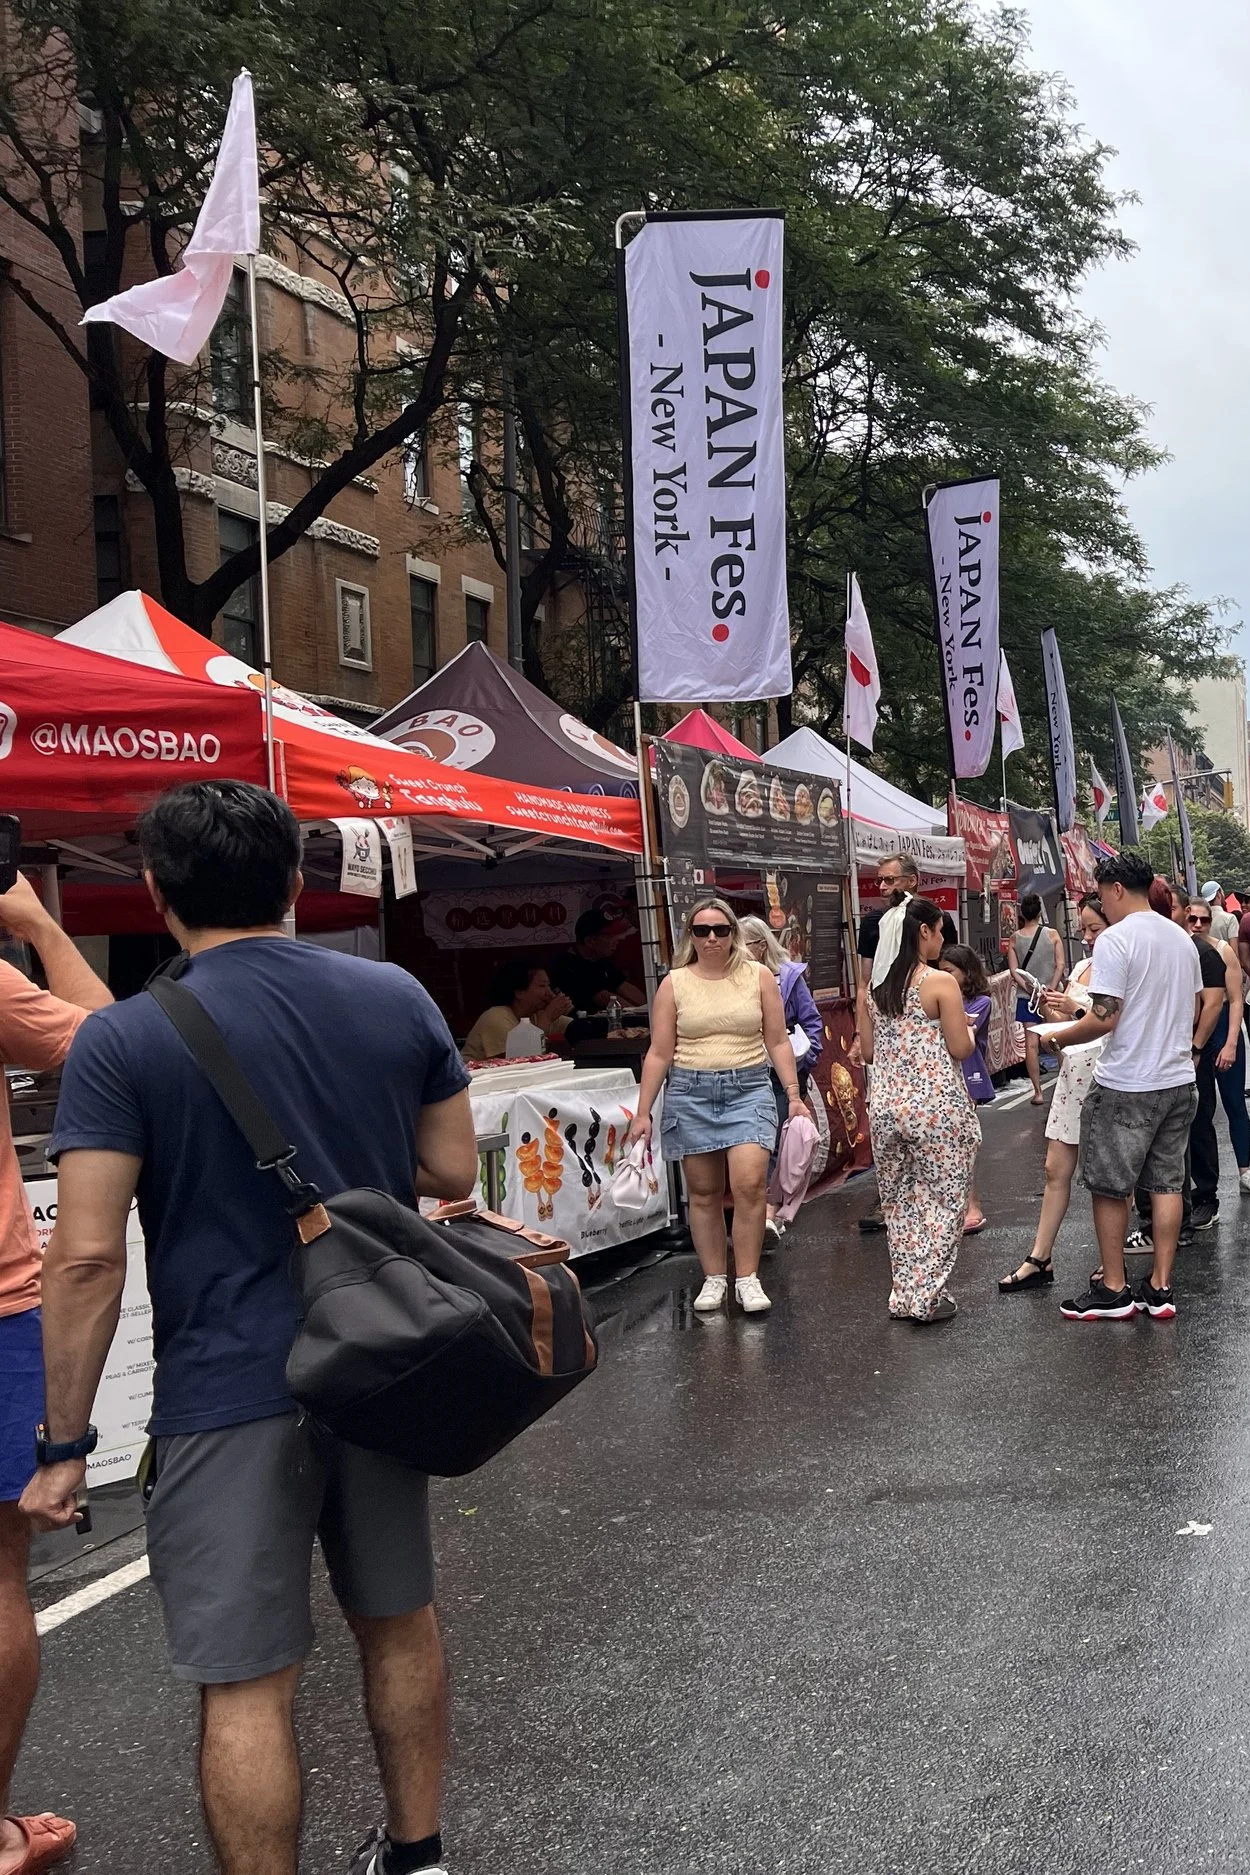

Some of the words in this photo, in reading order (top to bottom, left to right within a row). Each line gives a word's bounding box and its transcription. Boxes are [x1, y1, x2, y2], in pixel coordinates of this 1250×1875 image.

[689, 267, 770, 491] JAPAN
[649, 361, 685, 453] New
[652, 462, 691, 557] York
[710, 516, 758, 643] Fes.
[939, 571, 951, 627] New
[954, 510, 992, 650] JAPAN
[944, 637, 959, 693] York
[408, 714, 483, 737] BAO
[962, 661, 985, 742] Fes.
[1051, 691, 1060, 729] New
[30, 722, 221, 763] @MAOSBAO
[1052, 736, 1062, 773] York
[388, 773, 426, 790] Sweet
[427, 777, 468, 794] Crunch
[399, 788, 484, 813] Tanghulu
[514, 791, 566, 812] HANDMADE
[566, 801, 613, 820] HAPPINESS
[898, 835, 921, 857] JAPAN
[920, 840, 935, 860] Fes.
